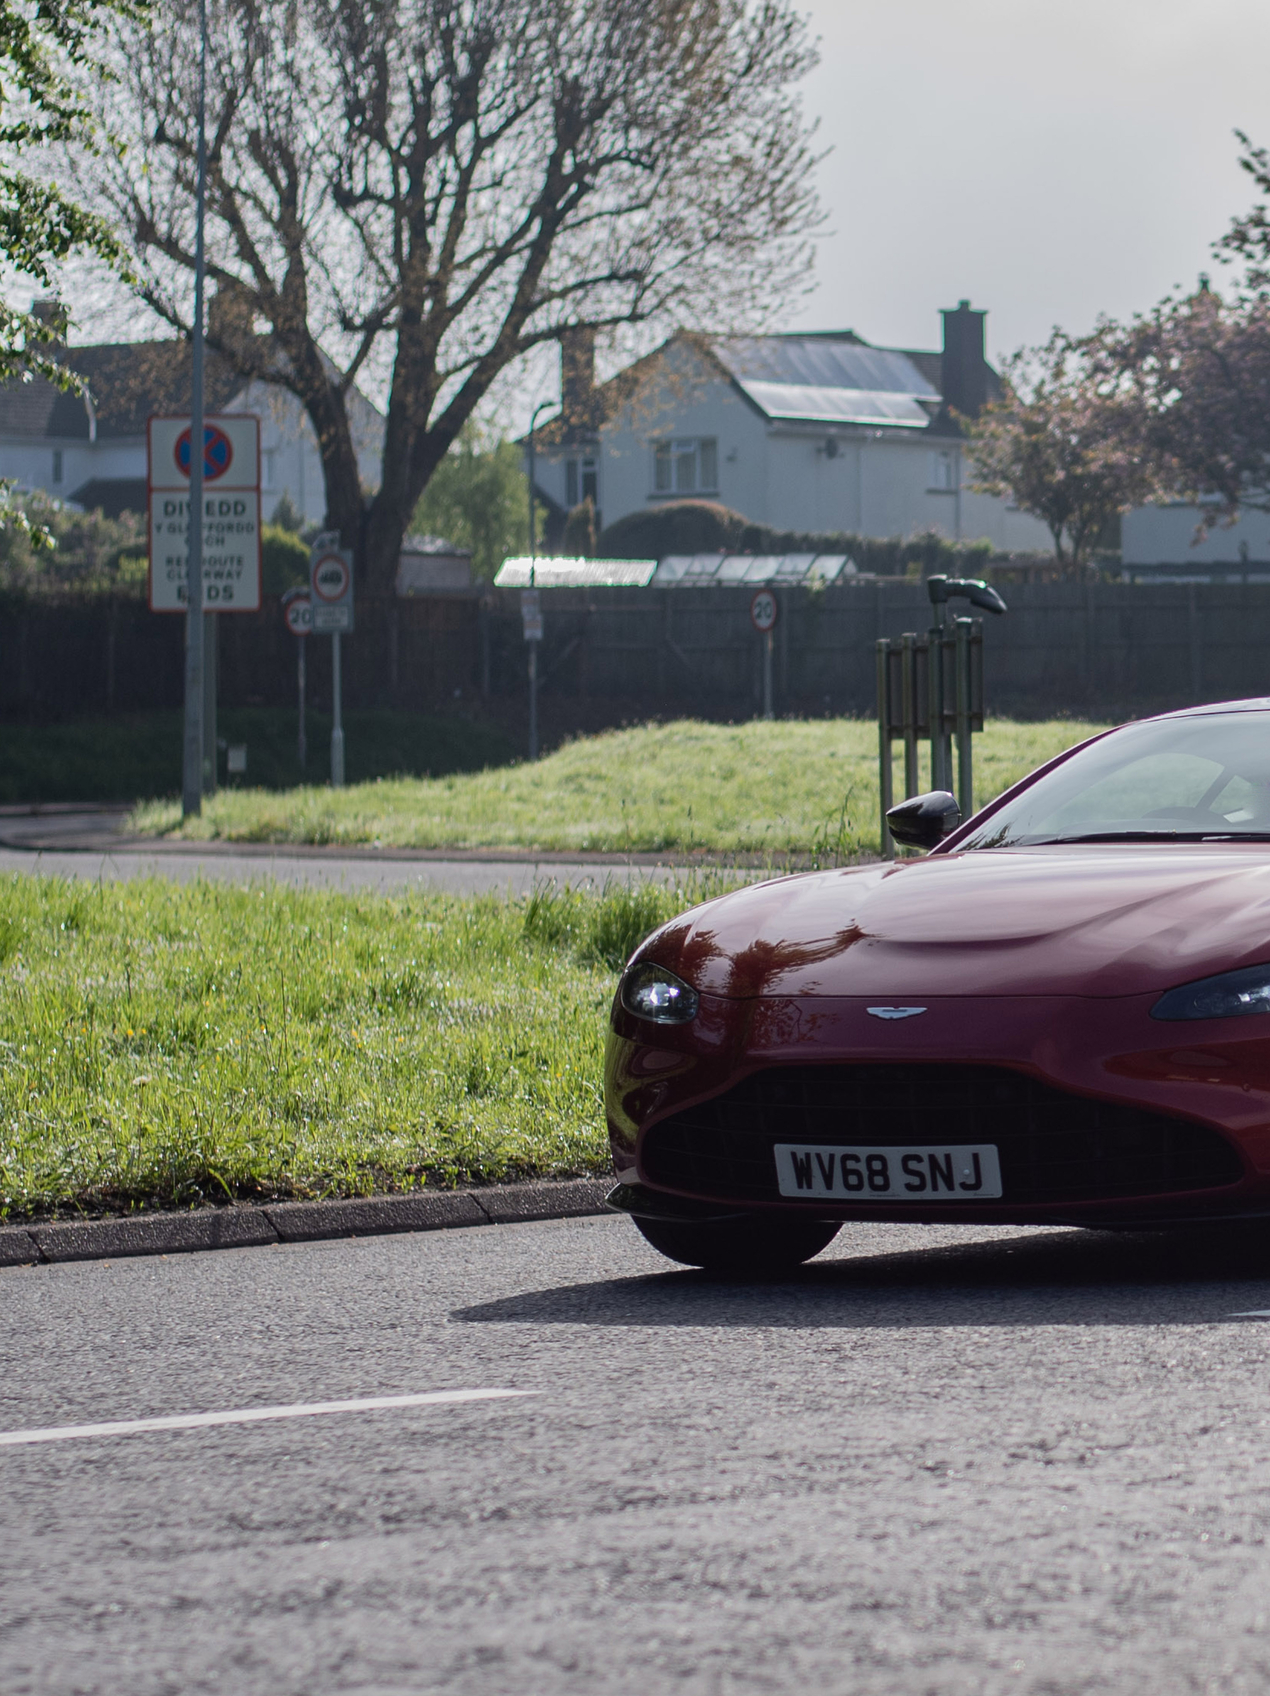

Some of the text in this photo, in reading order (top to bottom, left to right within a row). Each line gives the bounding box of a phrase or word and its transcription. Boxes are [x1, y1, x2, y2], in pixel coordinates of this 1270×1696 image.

[163, 500, 246, 517] DIEDD
[177, 585, 234, 601] EDS
[289, 608, 311, 624] 20
[755, 601, 773, 619] 20
[790, 1151, 982, 1192] WV68 SNJ
